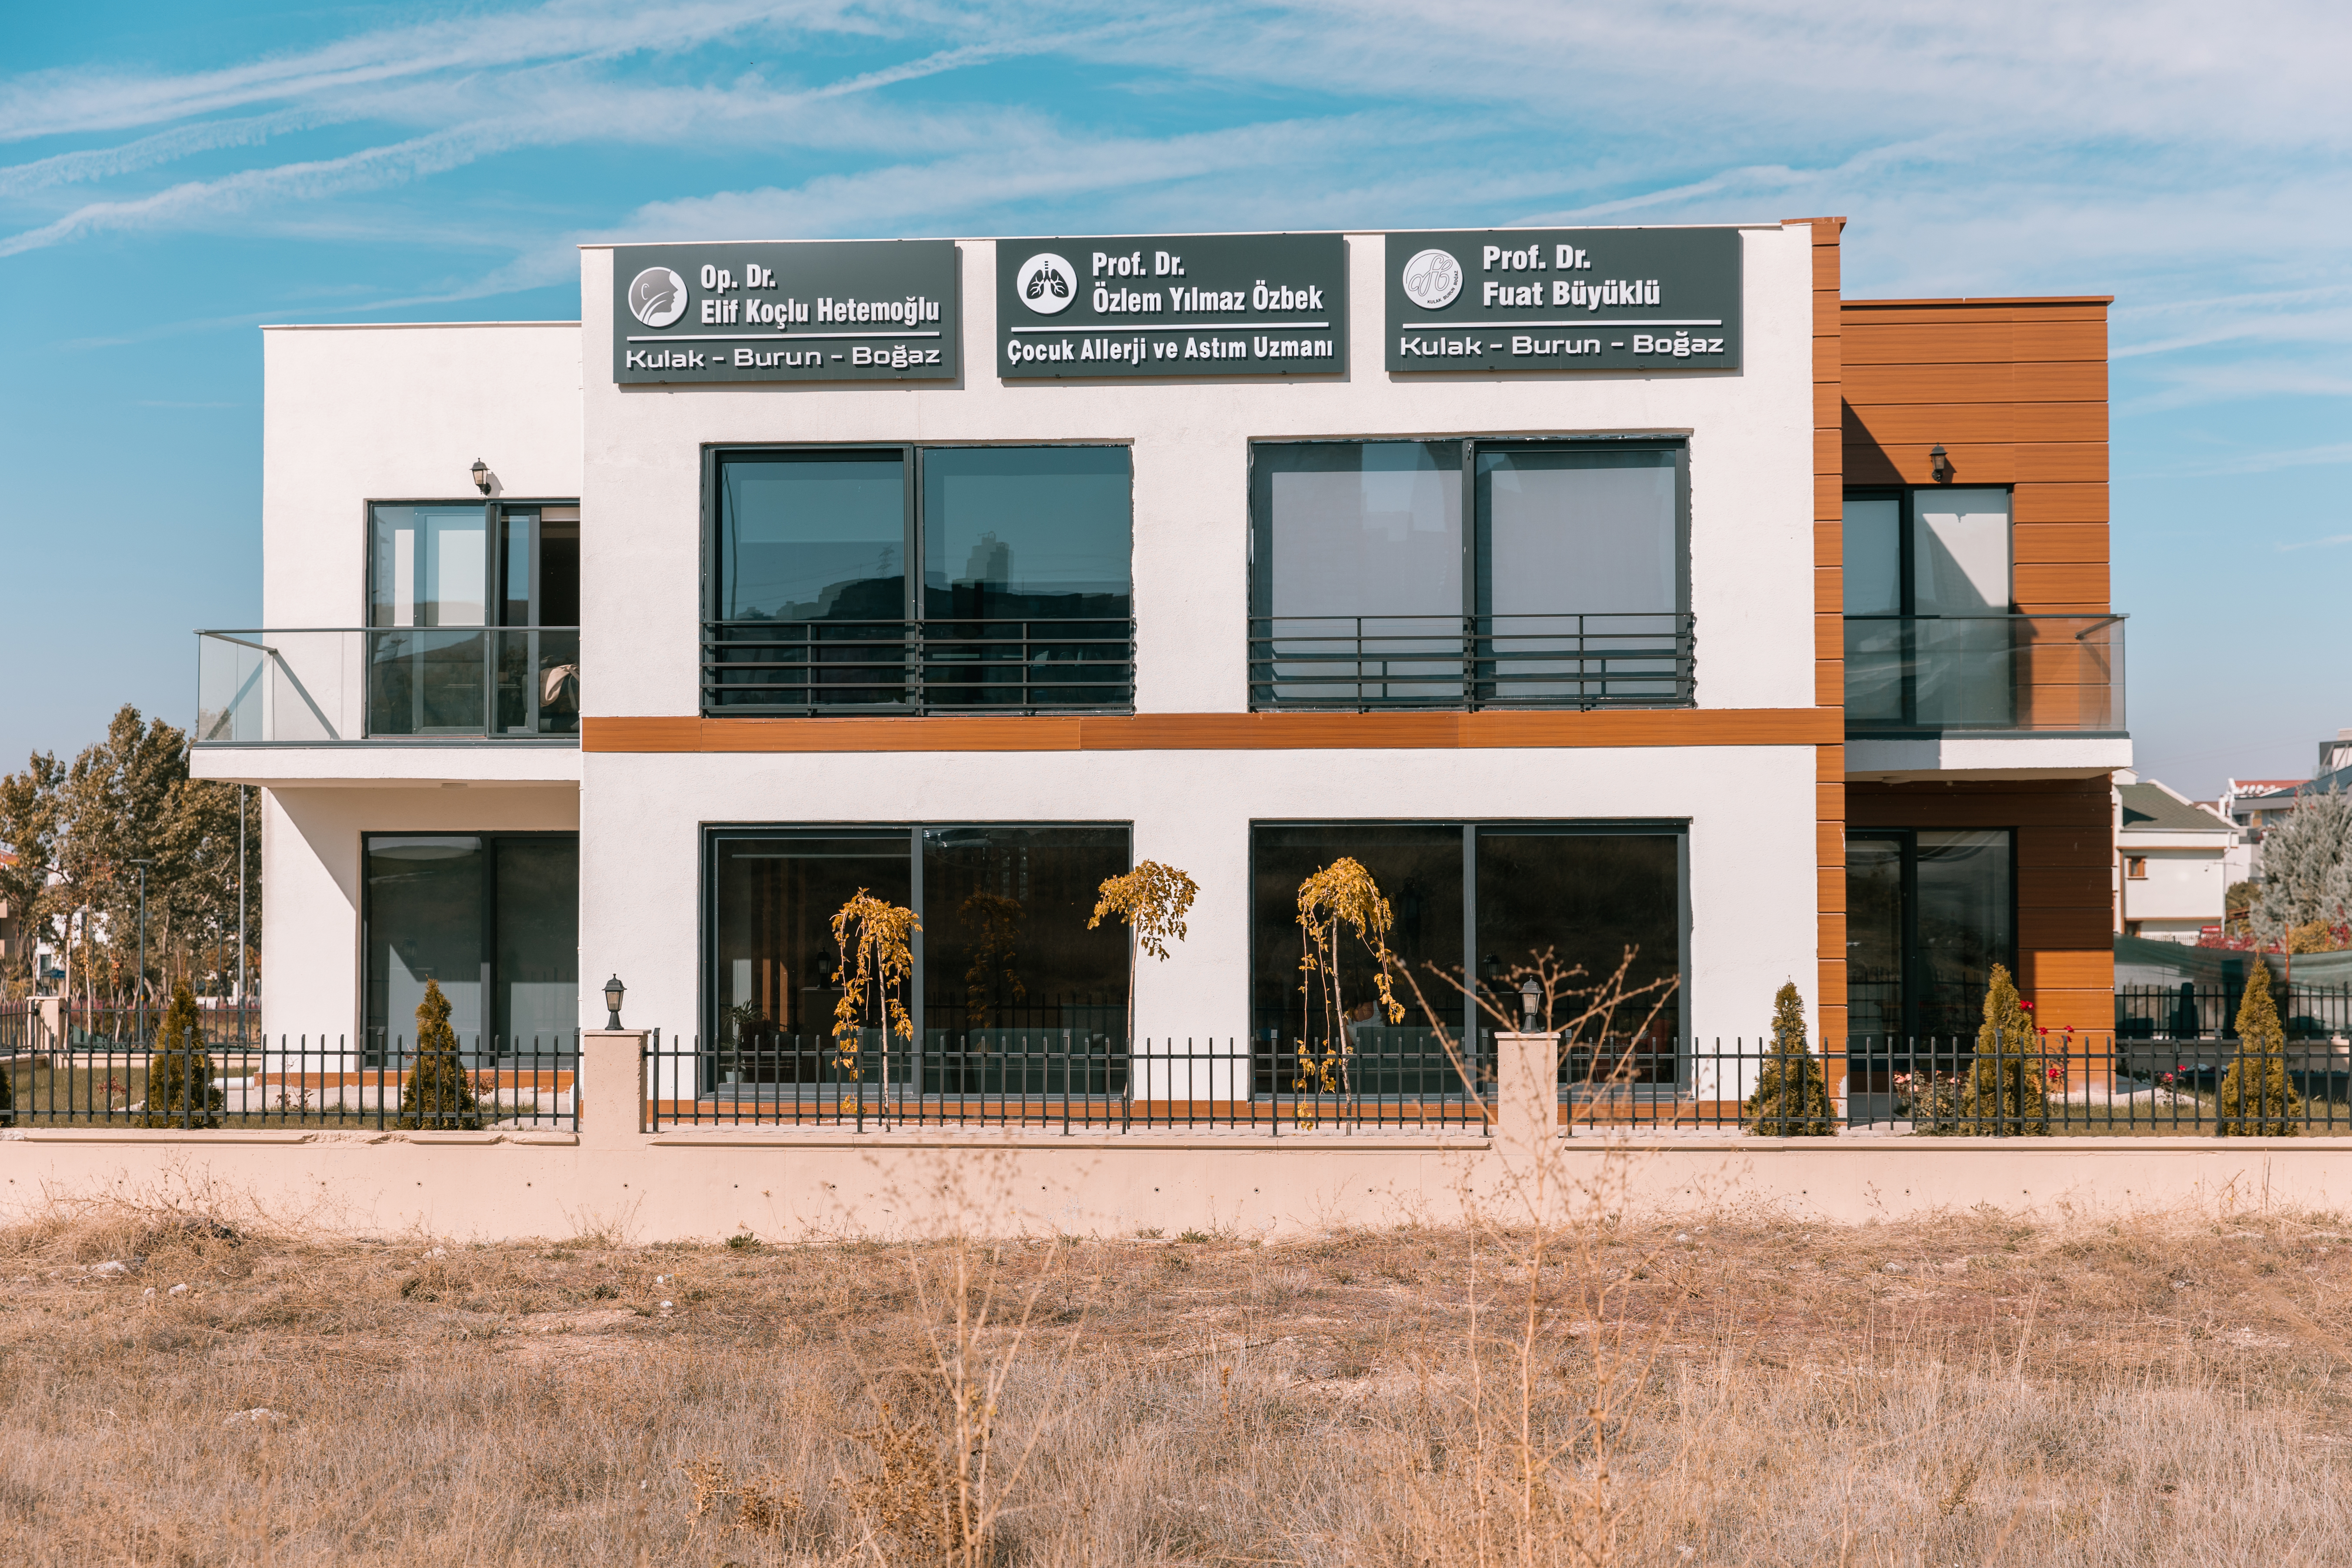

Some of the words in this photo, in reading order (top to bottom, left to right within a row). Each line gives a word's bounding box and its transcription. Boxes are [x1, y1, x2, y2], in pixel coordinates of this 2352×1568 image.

[1092, 251, 1146, 277] Prof.
[1155, 251, 1185, 275] Dr.
[1483, 244, 1547, 270] Prof.
[1556, 244, 1591, 269] Dr.
[700, 264, 738, 294] Op.
[746, 263, 776, 288] Dr.
[1093, 281, 1162, 313] Özlem
[1168, 286, 1246, 311] Yılmaz
[1253, 279, 1323, 311] Özbek
[1443, 287, 1455, 300] BURUN
[1483, 281, 1544, 306] Fuat
[1552, 279, 1660, 311] Büyüklü
[701, 299, 738, 324] Elif
[745, 298, 808, 330] Koçlu
[817, 296, 939, 326] Hetemoğlu
[626, 349, 705, 368] Kulak
[734, 348, 822, 367] Burun
[852, 344, 940, 368] Boğaz
[1007, 339, 1075, 365] Çocuk
[1080, 337, 1146, 365] Allerji
[1153, 341, 1178, 359] ve
[1184, 337, 1246, 358] Astım
[1253, 336, 1333, 358] Uzmanı
[1400, 336, 1482, 356] Kulak
[1512, 335, 1600, 354] Burun
[1633, 330, 1724, 357] Boğaz
